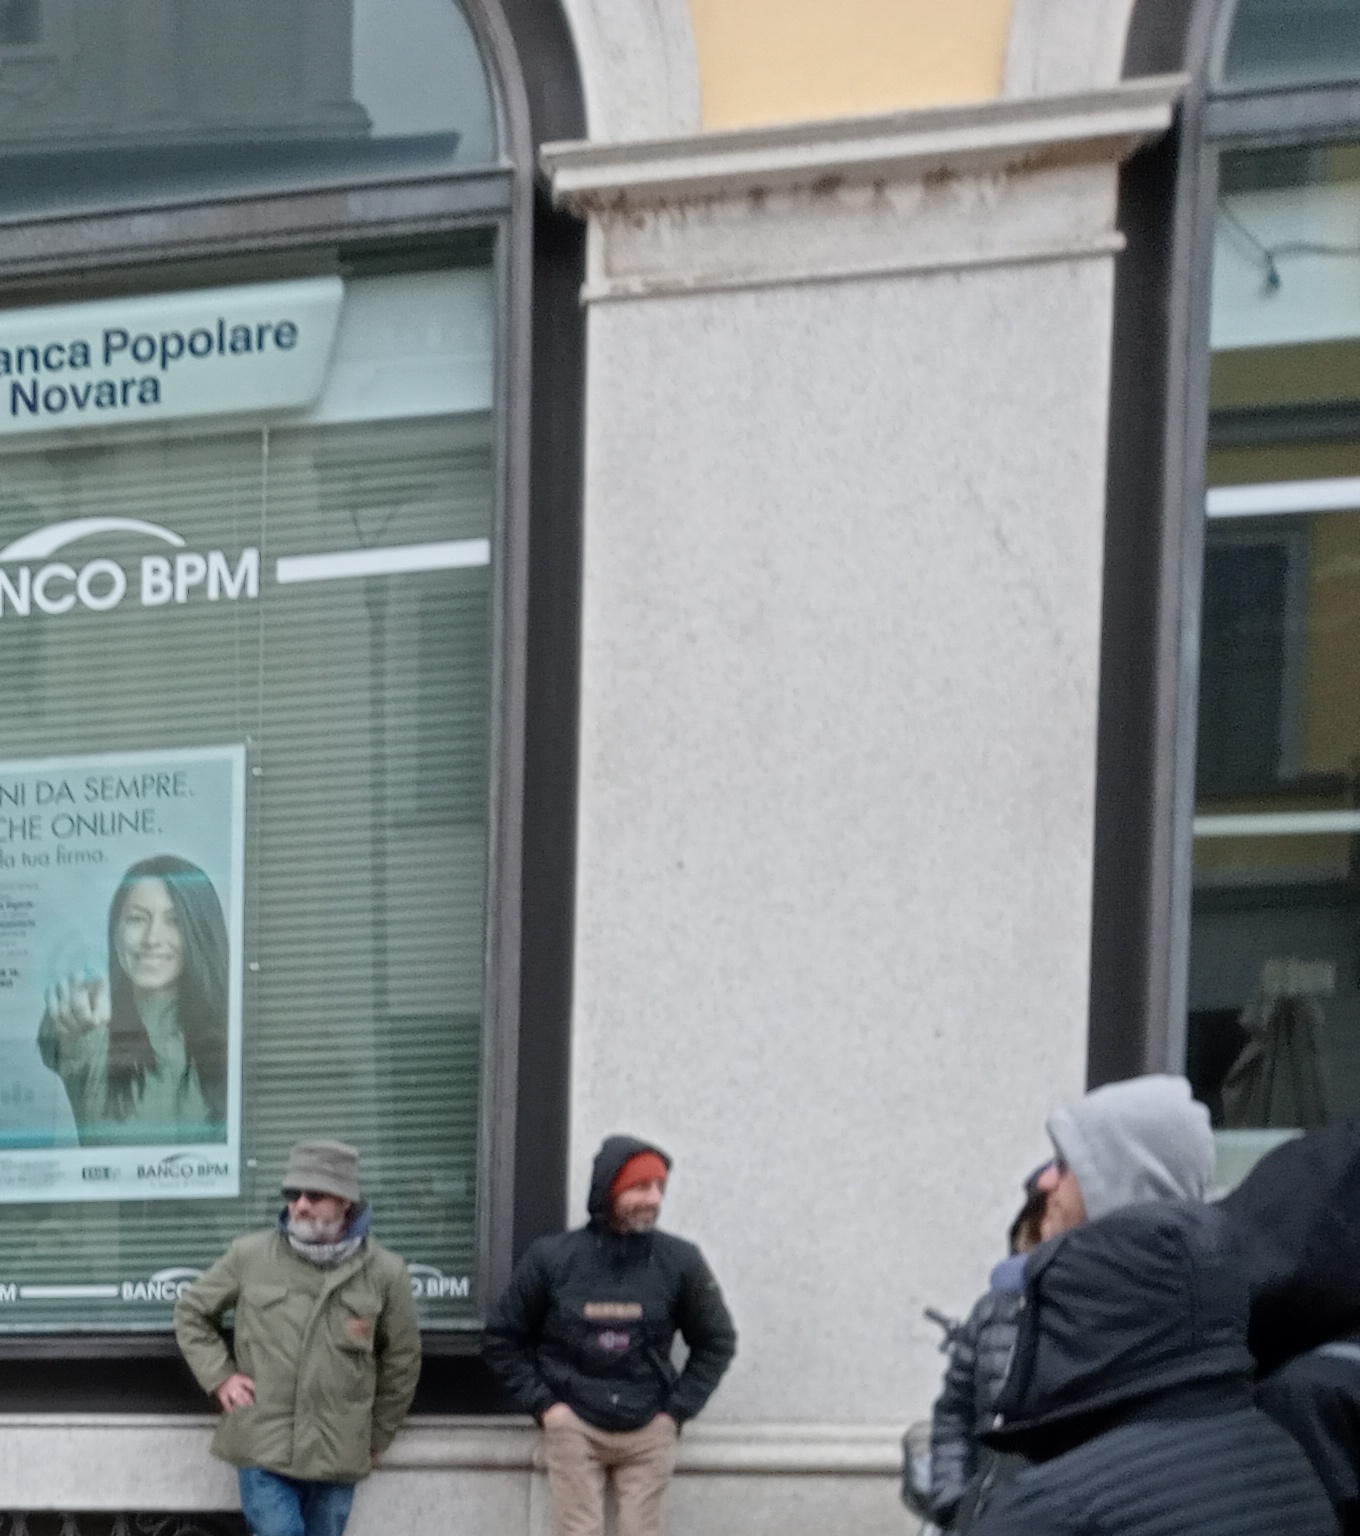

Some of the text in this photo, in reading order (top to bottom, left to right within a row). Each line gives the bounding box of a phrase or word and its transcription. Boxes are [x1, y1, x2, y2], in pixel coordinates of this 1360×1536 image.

[103, 318, 299, 370] Popolare
[10, 375, 161, 416] Novara
[140, 547, 260, 607] BPM
[35, 780, 76, 805] DA
[84, 771, 196, 803] SEMPRE.
[51, 808, 163, 840] ONLINE.
[21, 852, 50, 867] tua
[137, 1163, 194, 1179] BANCO
[197, 1162, 228, 1177] BPM
[426, 1276, 470, 1297] BPM
